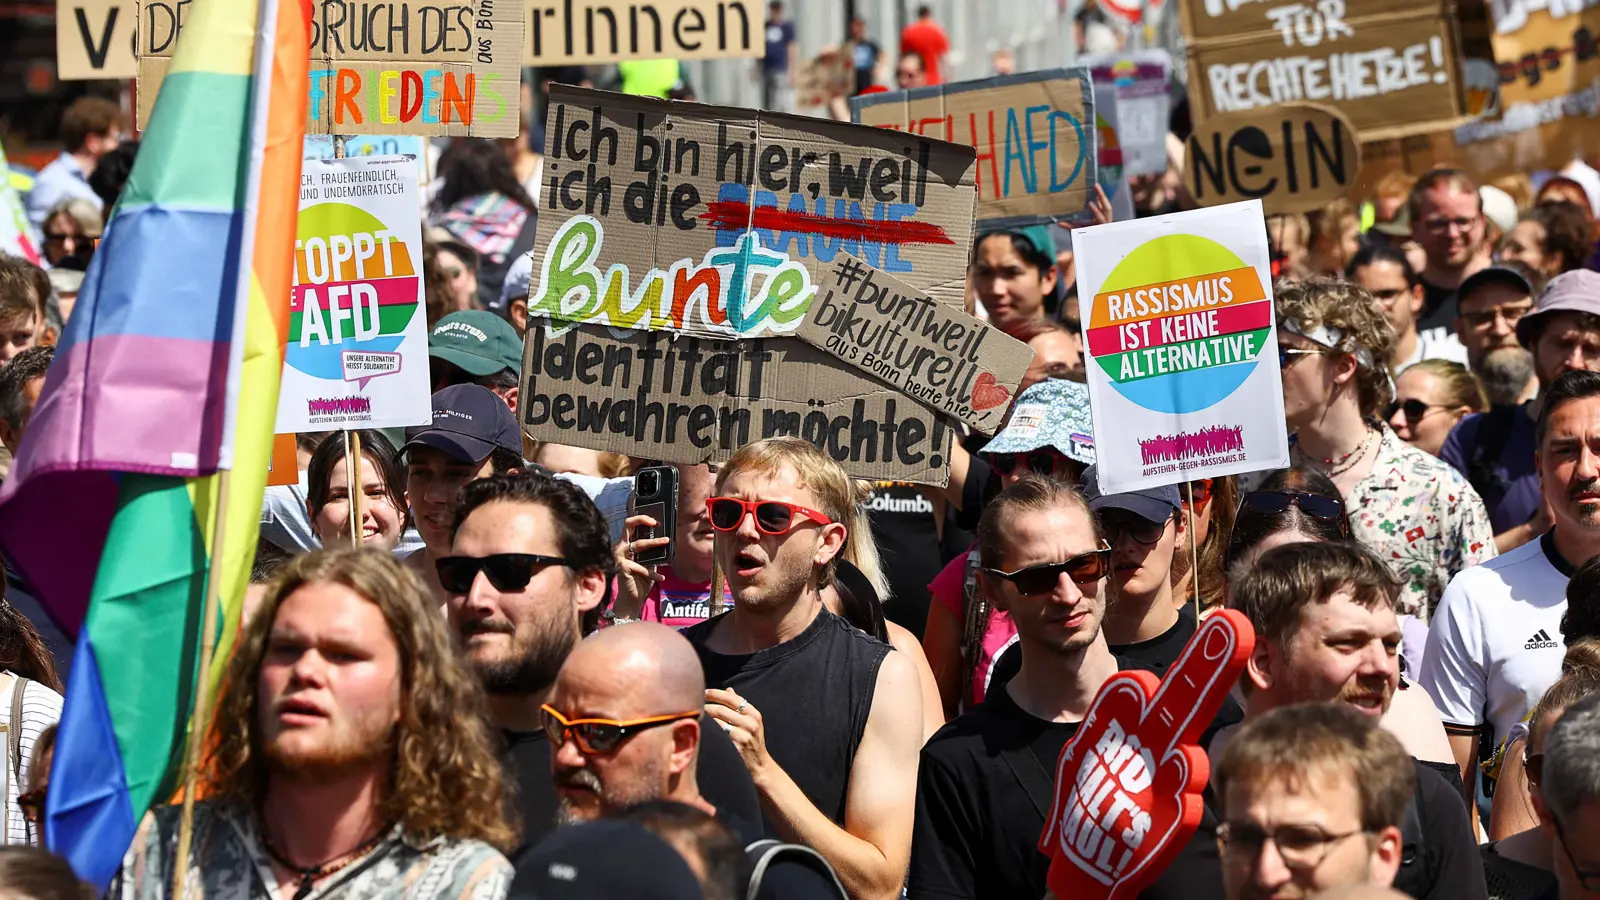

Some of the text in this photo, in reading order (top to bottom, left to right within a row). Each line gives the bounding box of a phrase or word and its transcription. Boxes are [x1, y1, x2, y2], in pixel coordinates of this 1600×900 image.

[418, 5, 474, 55] DES
[477, 37, 493, 63] aus
[309, 68, 508, 126] FRIEDENS
[552, 104, 618, 166] Ich
[634, 112, 700, 176] bin
[828, 141, 931, 207] weil
[324, 183, 404, 199] UNDEMOKRATISCH
[549, 163, 612, 216] ich
[623, 168, 701, 230] die
[300, 282, 381, 348] AFD
[1108, 277, 1233, 321] RASSISMUS
[813, 291, 978, 404] bikulturell
[1119, 310, 1220, 351] IST KEINE
[346, 354, 395, 363] UNSERE ALTERNATIVE
[346, 362, 362, 370] HEISST
[531, 327, 771, 401] Identität
[826, 335, 991, 425] aus Bonn heute hier!
[1119, 334, 1256, 381] ALTERNATIVE
[348, 414, 372, 422] RASSISMUS
[525, 375, 752, 449] bewahren
[762, 399, 943, 469] möchte!
[1143, 452, 1246, 477] AUFSTEHEN-GEGEN-RASSISMUS.DE
[664, 602, 710, 618] Antifa
[1524, 640, 1558, 650] adidas
